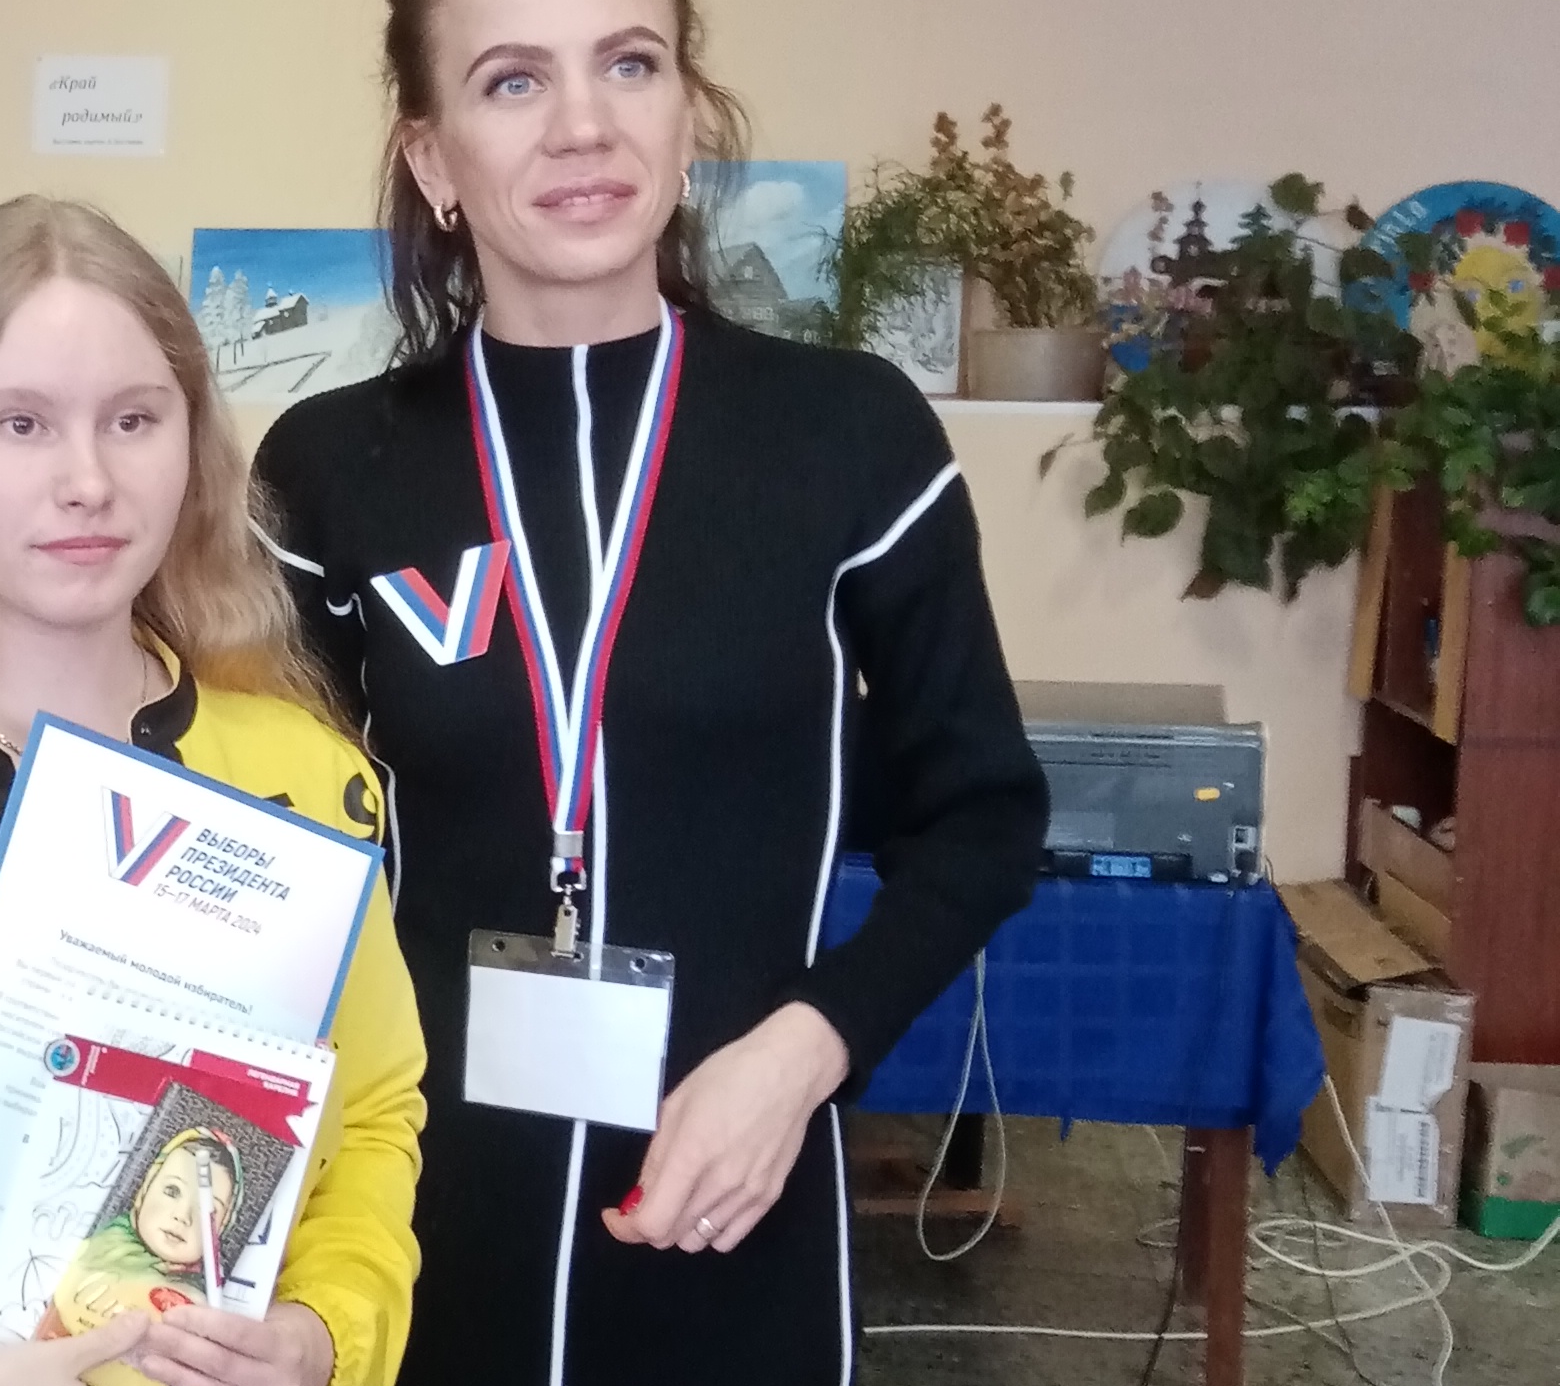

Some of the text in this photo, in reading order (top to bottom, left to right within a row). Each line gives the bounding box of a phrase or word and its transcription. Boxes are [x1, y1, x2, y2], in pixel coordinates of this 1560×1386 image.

[195, 827, 277, 869] ВЫБОРЫ
[165, 864, 240, 904] РОССИИ
[180, 846, 291, 902] ПРЕЗИДЕНТА
[190, 897, 232, 925] МАРТА
[231, 914, 264, 937] 2024
[59, 929, 127, 965] Уважаемый
[130, 958, 182, 988] молодой
[183, 981, 254, 1016] избиратель!
